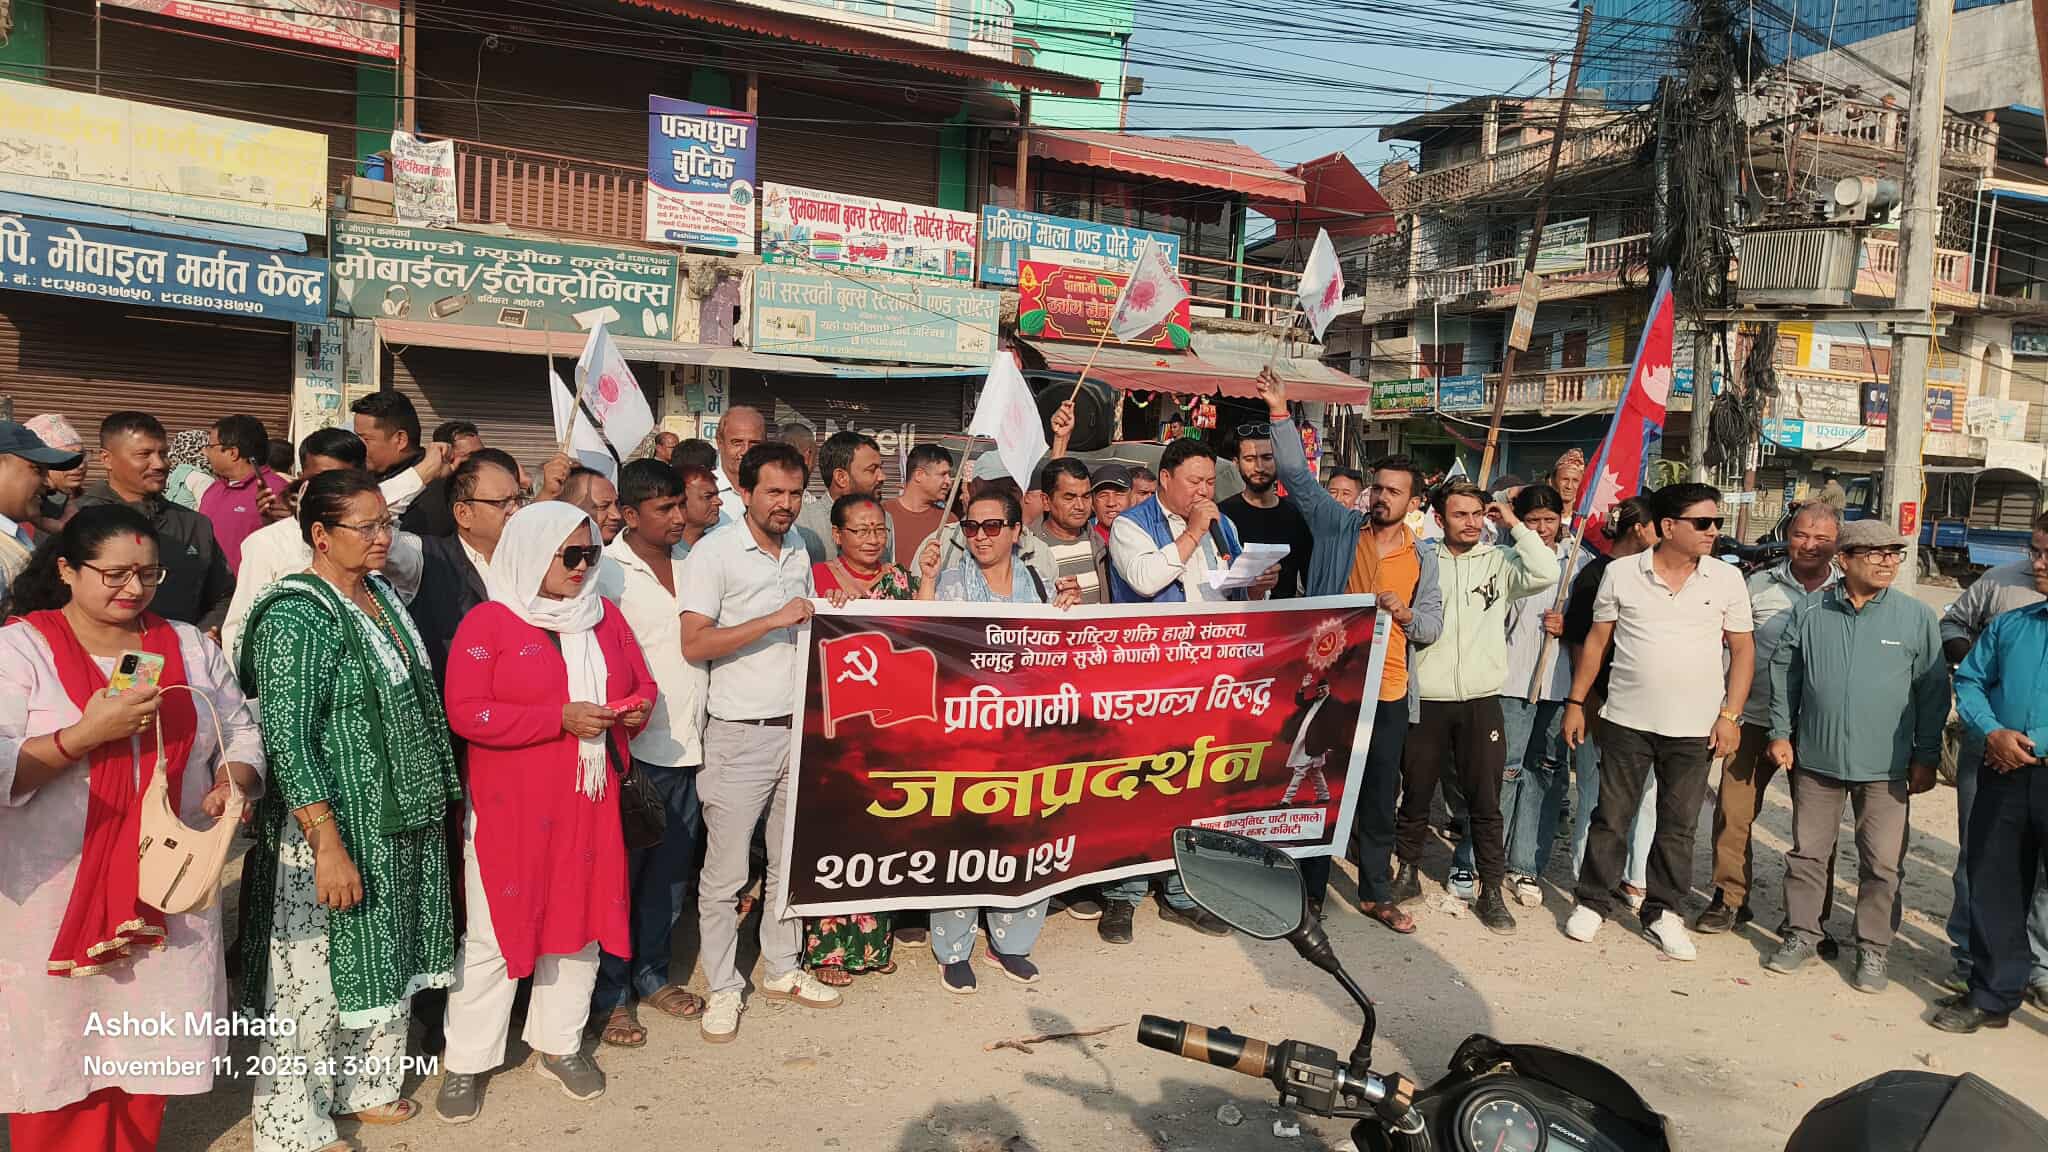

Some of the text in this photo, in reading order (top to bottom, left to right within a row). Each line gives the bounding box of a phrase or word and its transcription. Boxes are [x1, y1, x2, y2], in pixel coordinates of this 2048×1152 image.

[843, 204, 866, 233] बुक्स
[1036, 222, 1070, 249] माला
[1074, 229, 1103, 253] एण्ड
[1106, 227, 1130, 259] पोते
[176, 250, 250, 295] मर्मत
[257, 255, 325, 306] केन्द्र
[837, 287, 868, 313] बुक्स
[985, 624, 1062, 647] निर्णायक
[1162, 621, 1197, 642] हाम्रो
[1020, 647, 1068, 668] नेपाल
[1073, 646, 1108, 670] सुखी
[1112, 644, 1161, 666] नेपाली
[943, 682, 1084, 734] प्रतिगामी
[866, 736, 1273, 819] जनप्रदर्शन
[814, 848, 937, 890] २०८२
